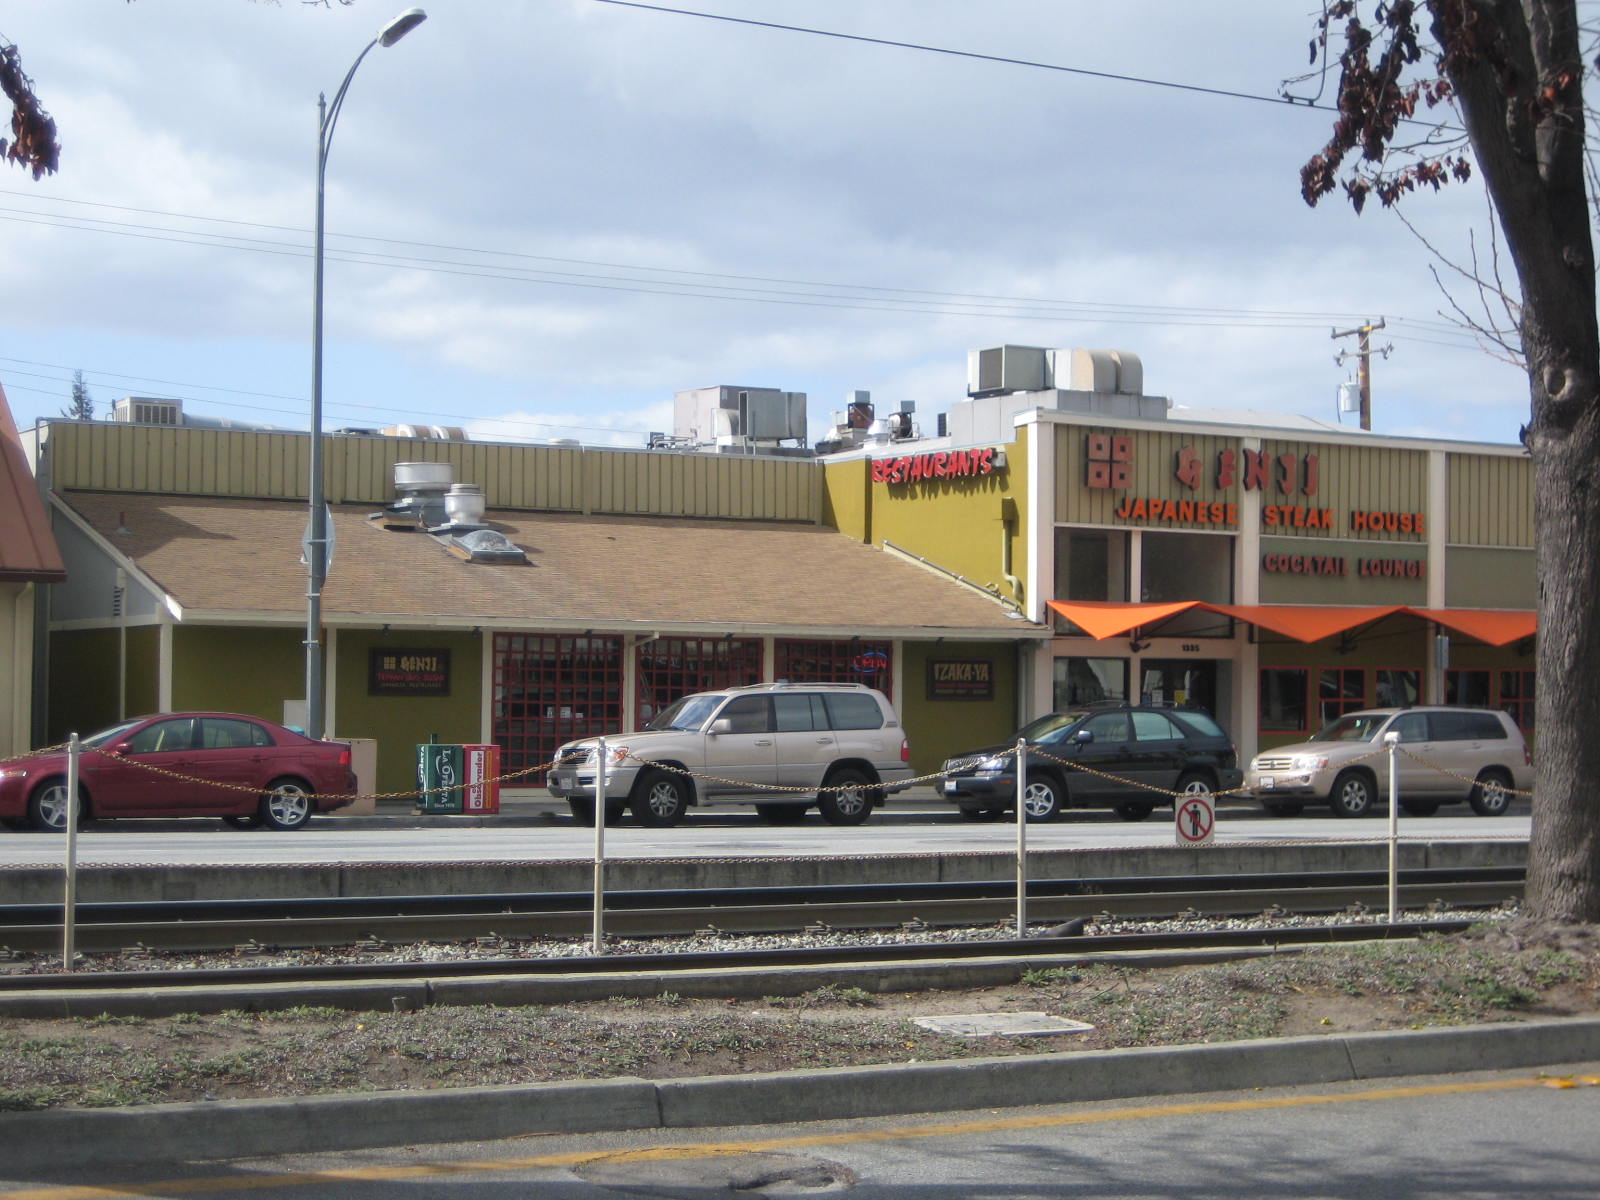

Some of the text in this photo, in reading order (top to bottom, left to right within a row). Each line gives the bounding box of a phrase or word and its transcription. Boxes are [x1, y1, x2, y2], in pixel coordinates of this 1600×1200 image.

[872, 448, 993, 483] RESTAURANTS
[1175, 445, 1319, 496] GENJI
[1116, 499, 1426, 533] JAPANESE STEAK HOUSE
[1264, 554, 1428, 577] COCKTAIL LOUNGE
[401, 656, 437, 671] GENJI
[934, 663, 988, 680] IZAKA-YA
[474, 752, 483, 808] Observador
